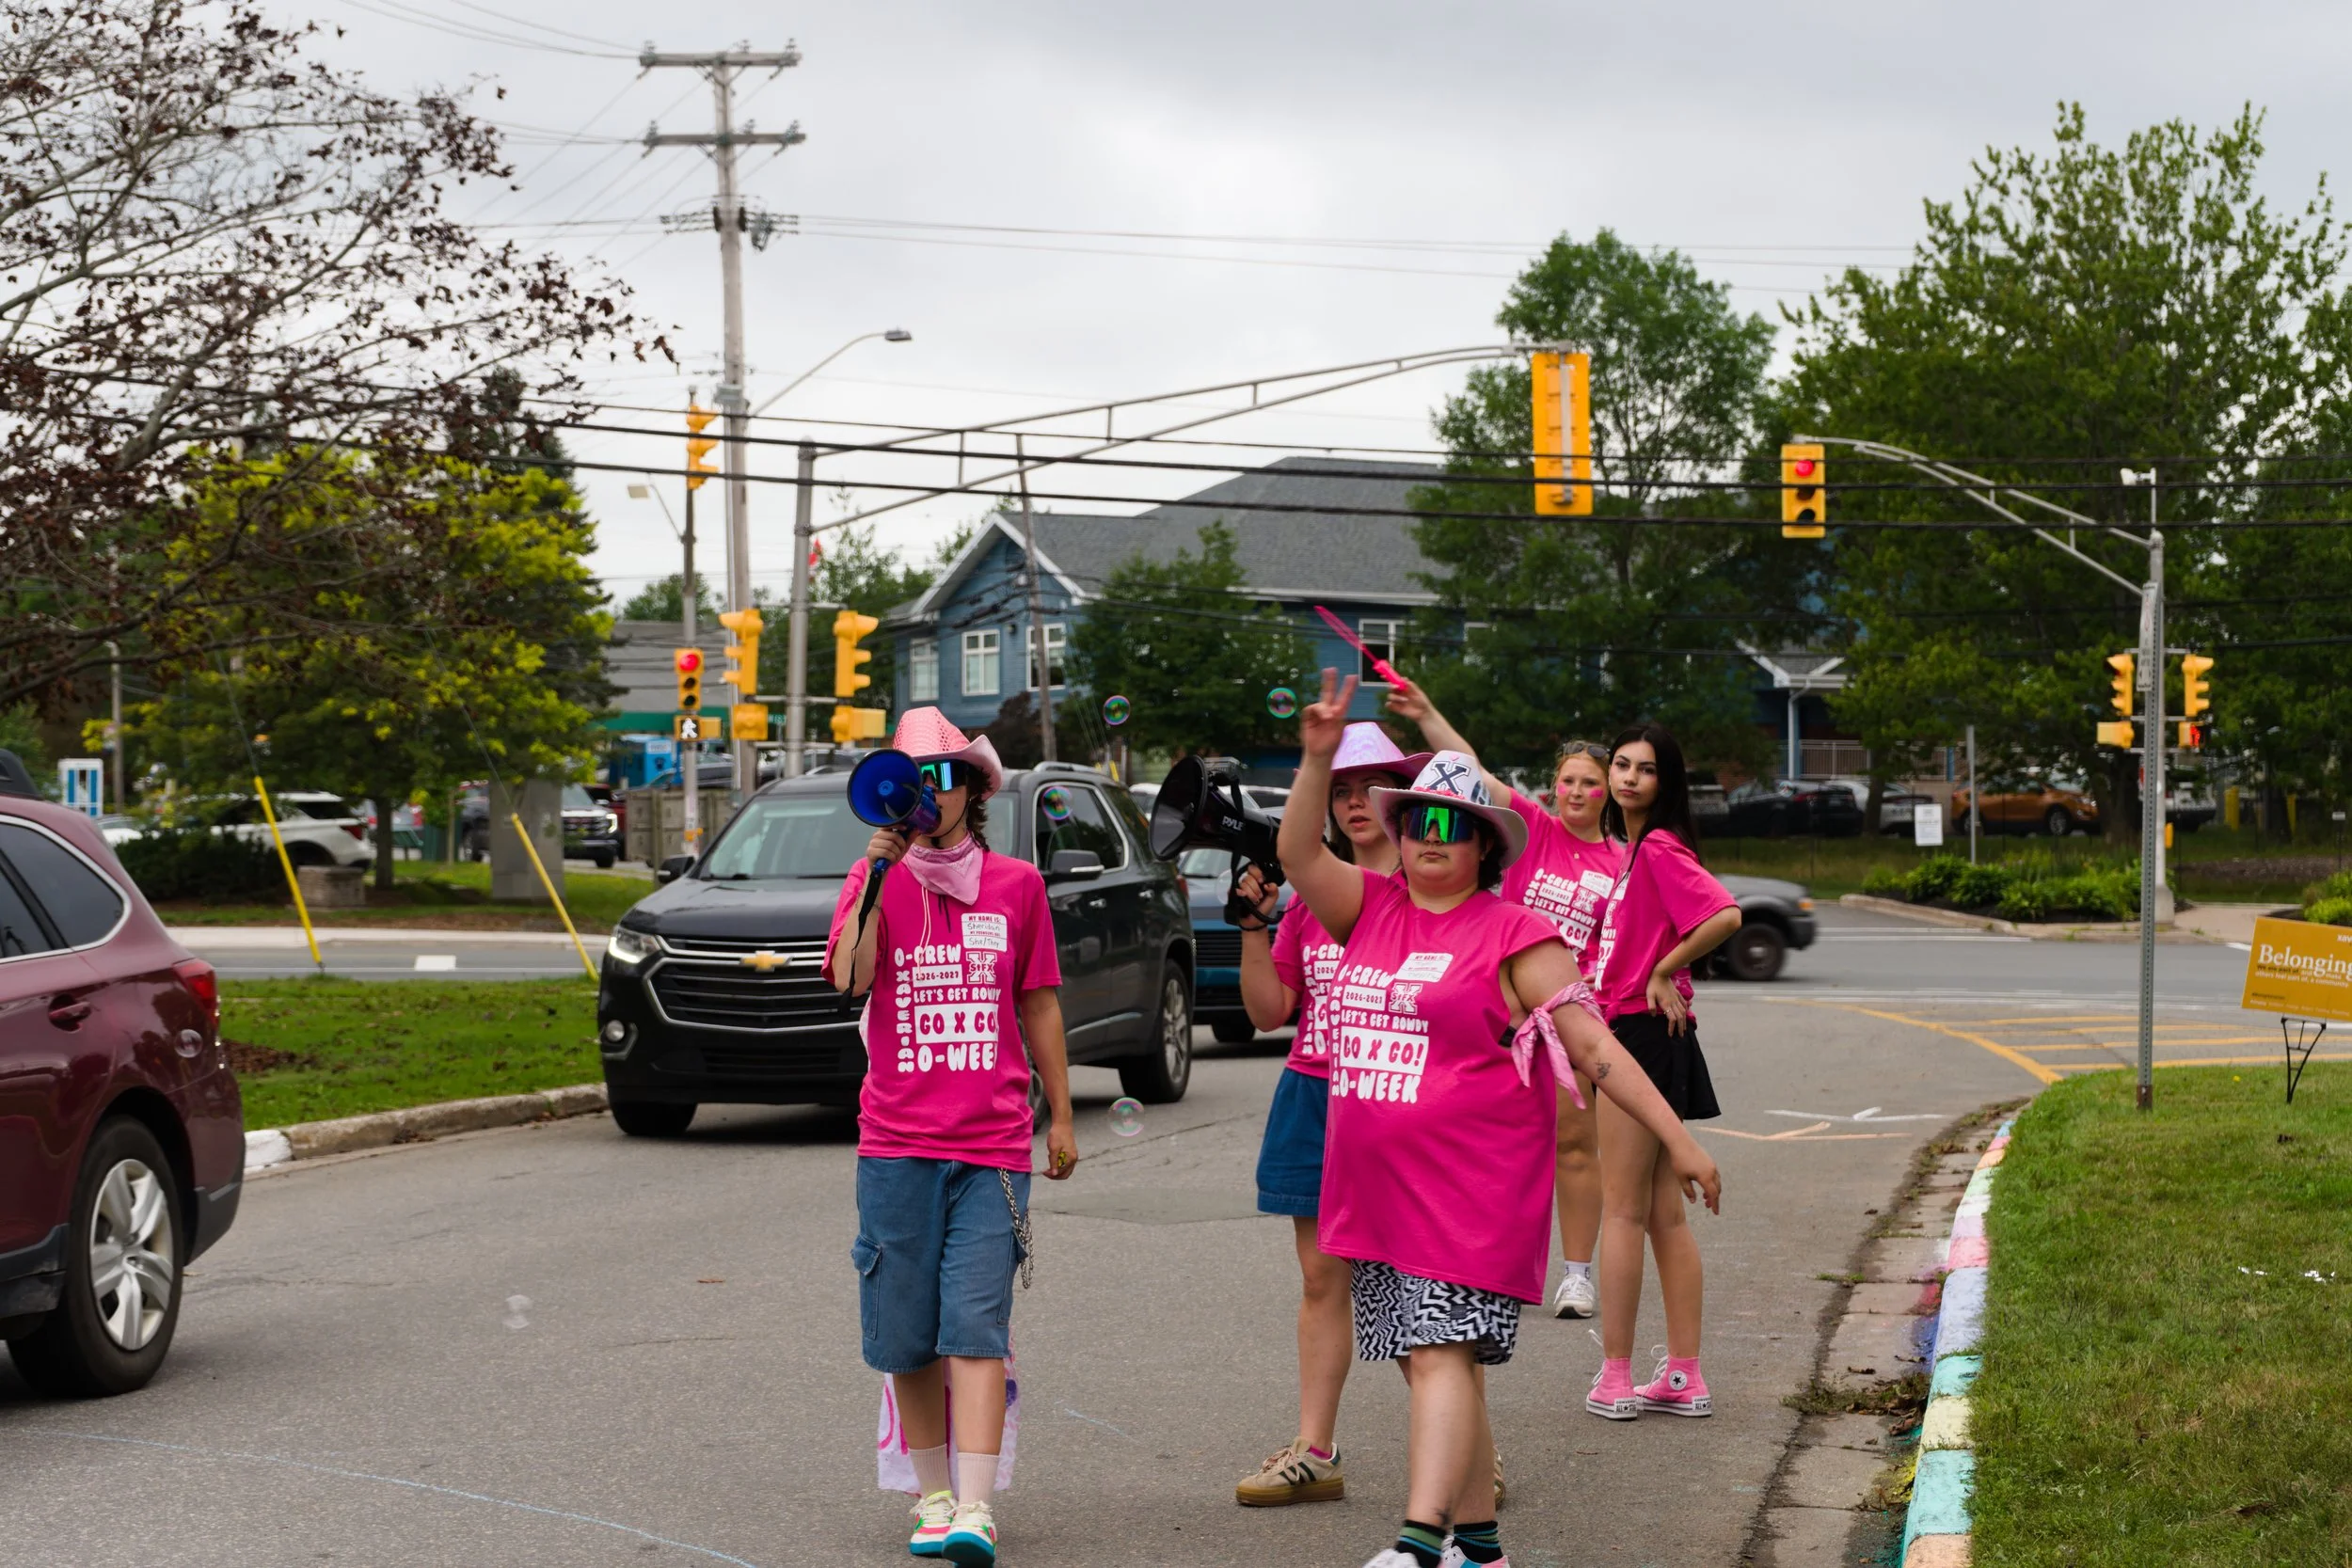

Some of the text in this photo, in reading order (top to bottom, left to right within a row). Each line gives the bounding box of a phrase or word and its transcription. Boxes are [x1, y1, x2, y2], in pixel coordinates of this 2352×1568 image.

[1424, 761, 1470, 795] X
[1534, 868, 1578, 893] O-CREW
[895, 943, 961, 967] O-CREW
[1338, 963, 1395, 988] O-CREW
[914, 988, 944, 1003] LET'S
[947, 988, 968, 1002] GET
[895, 970, 914, 1072] XAVERIAN
[919, 1013, 945, 1035] GO
[954, 1011, 965, 1033] X
[1341, 1009, 1428, 1033] LET'S GET ROWDY
[1329, 986, 1343, 1096] XAVERIAN
[1343, 1036, 1361, 1059] GO
[1368, 1038, 1382, 1060] X
[1389, 1040, 1423, 1067] GO!
[1340, 1069, 1421, 1103] O-WEEK
